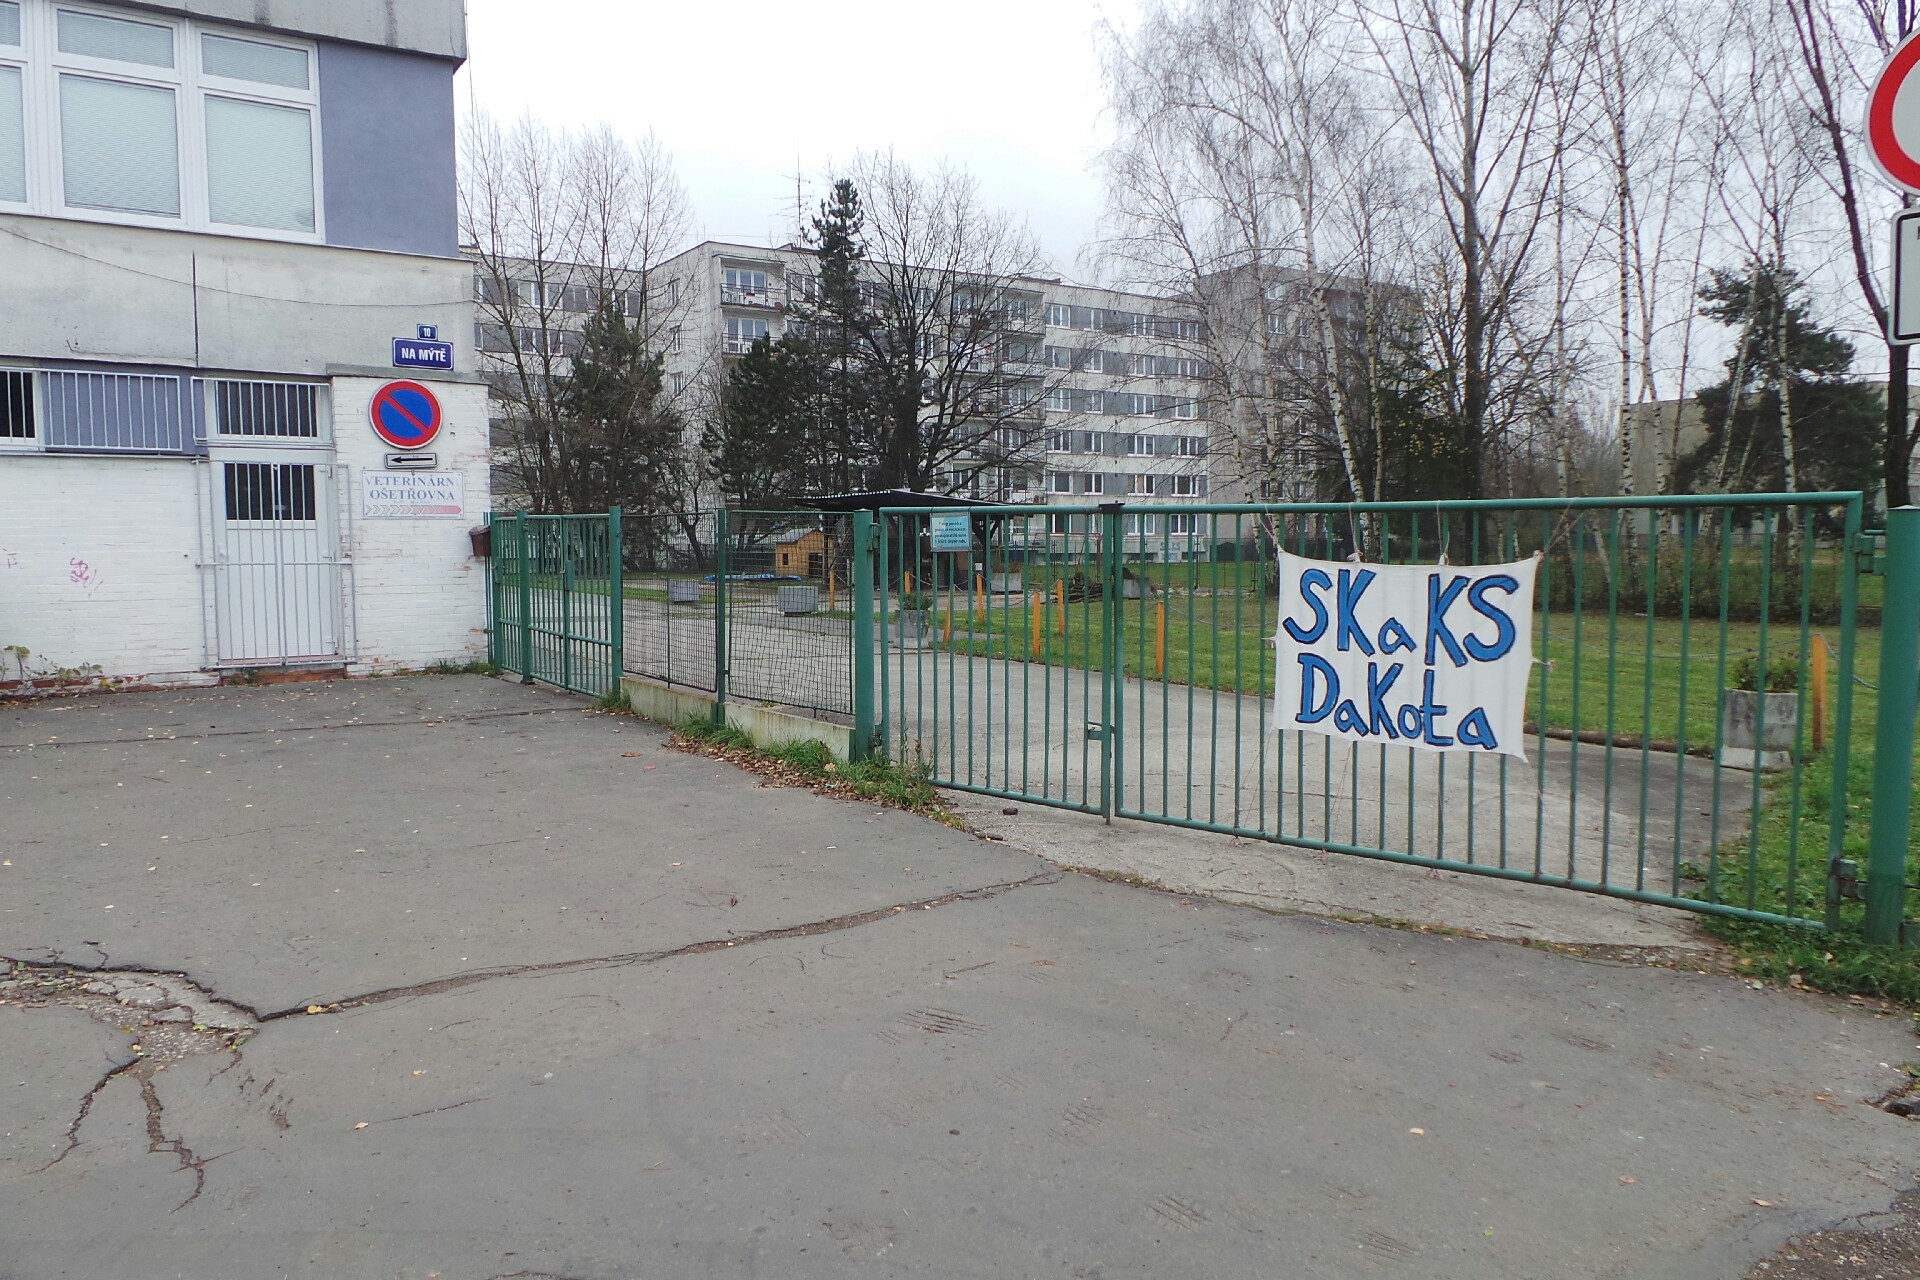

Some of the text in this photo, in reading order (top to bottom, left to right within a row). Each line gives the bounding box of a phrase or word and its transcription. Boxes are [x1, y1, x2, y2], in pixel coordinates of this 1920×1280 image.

[423, 327, 431, 337] 10
[401, 347, 447, 362] NA MÝTĚ
[366, 474, 458, 487] VETERINÁRN
[370, 488, 455, 500] OŠETŘOVNA
